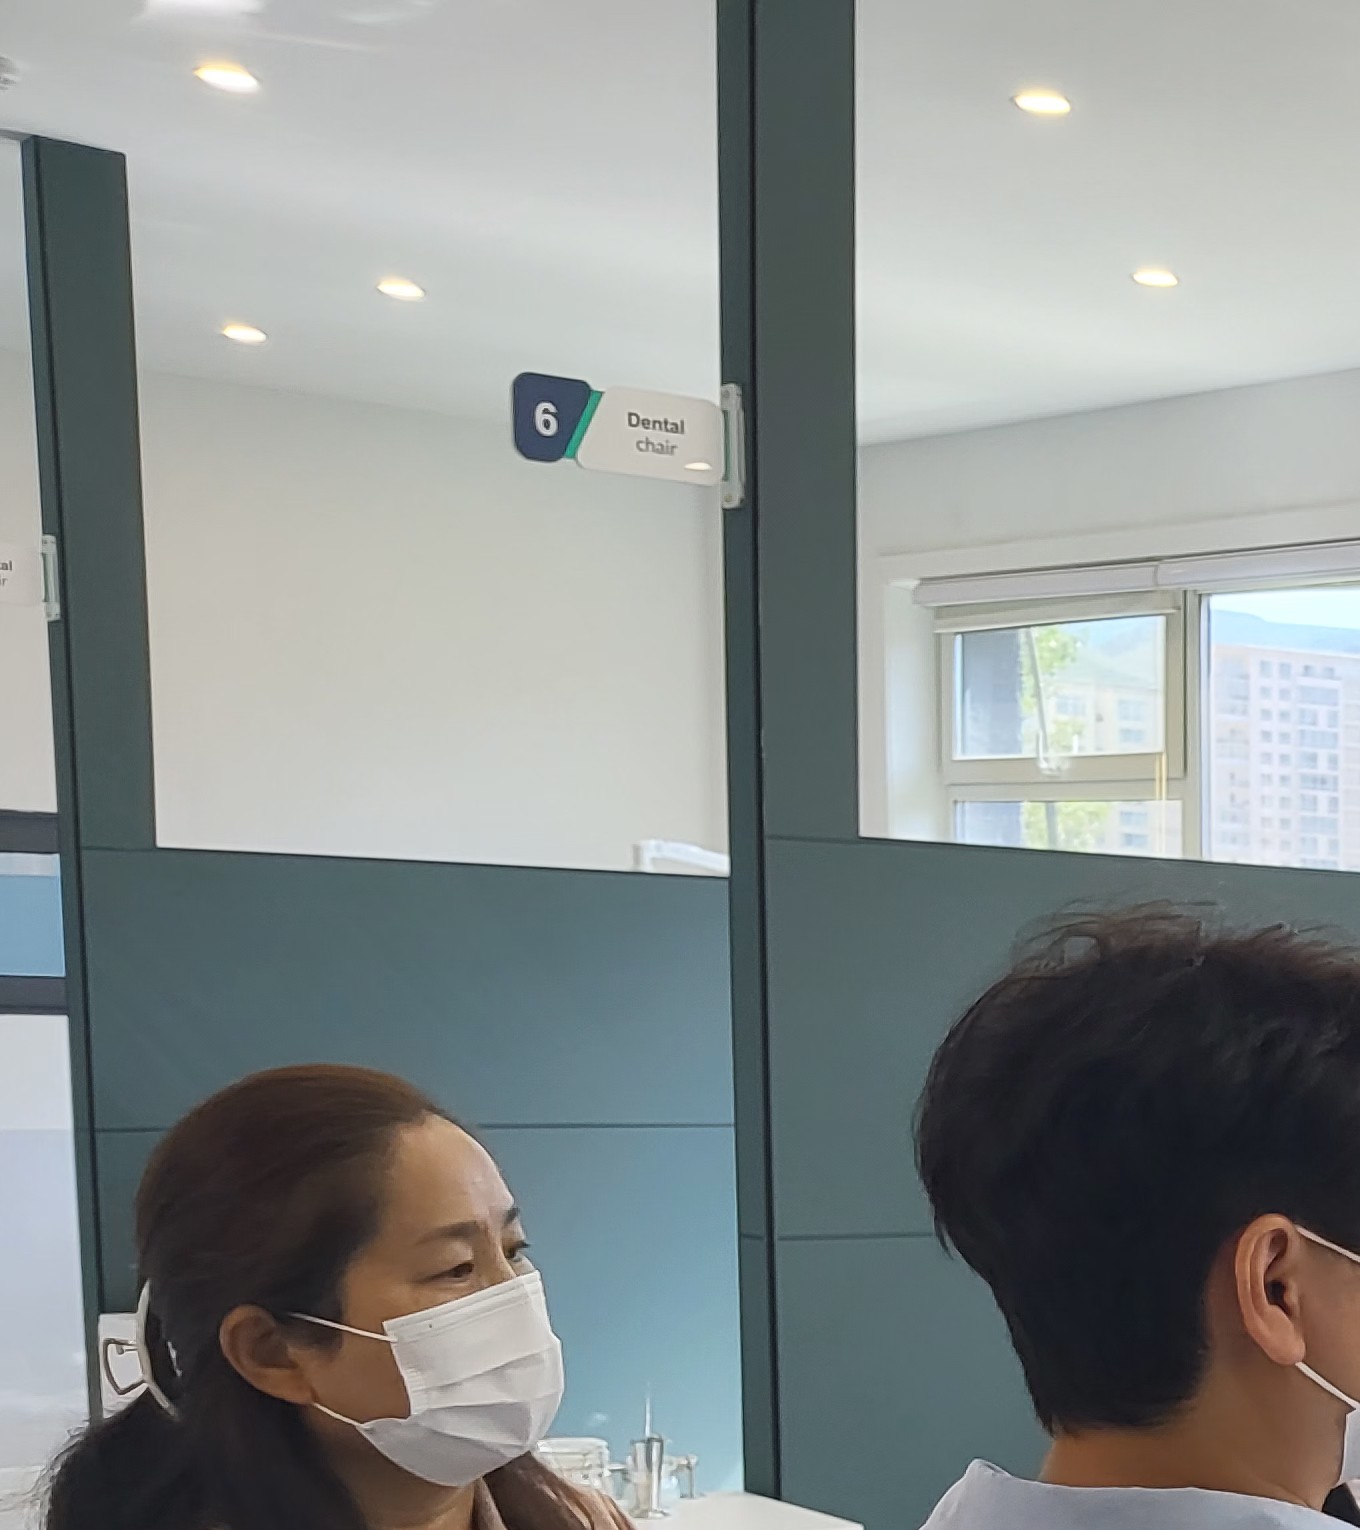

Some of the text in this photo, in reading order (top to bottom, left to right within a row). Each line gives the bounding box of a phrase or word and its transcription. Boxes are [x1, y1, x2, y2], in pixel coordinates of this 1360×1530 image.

[534, 401, 558, 437] 6
[627, 412, 685, 435] Dental
[636, 437, 678, 455] chair
